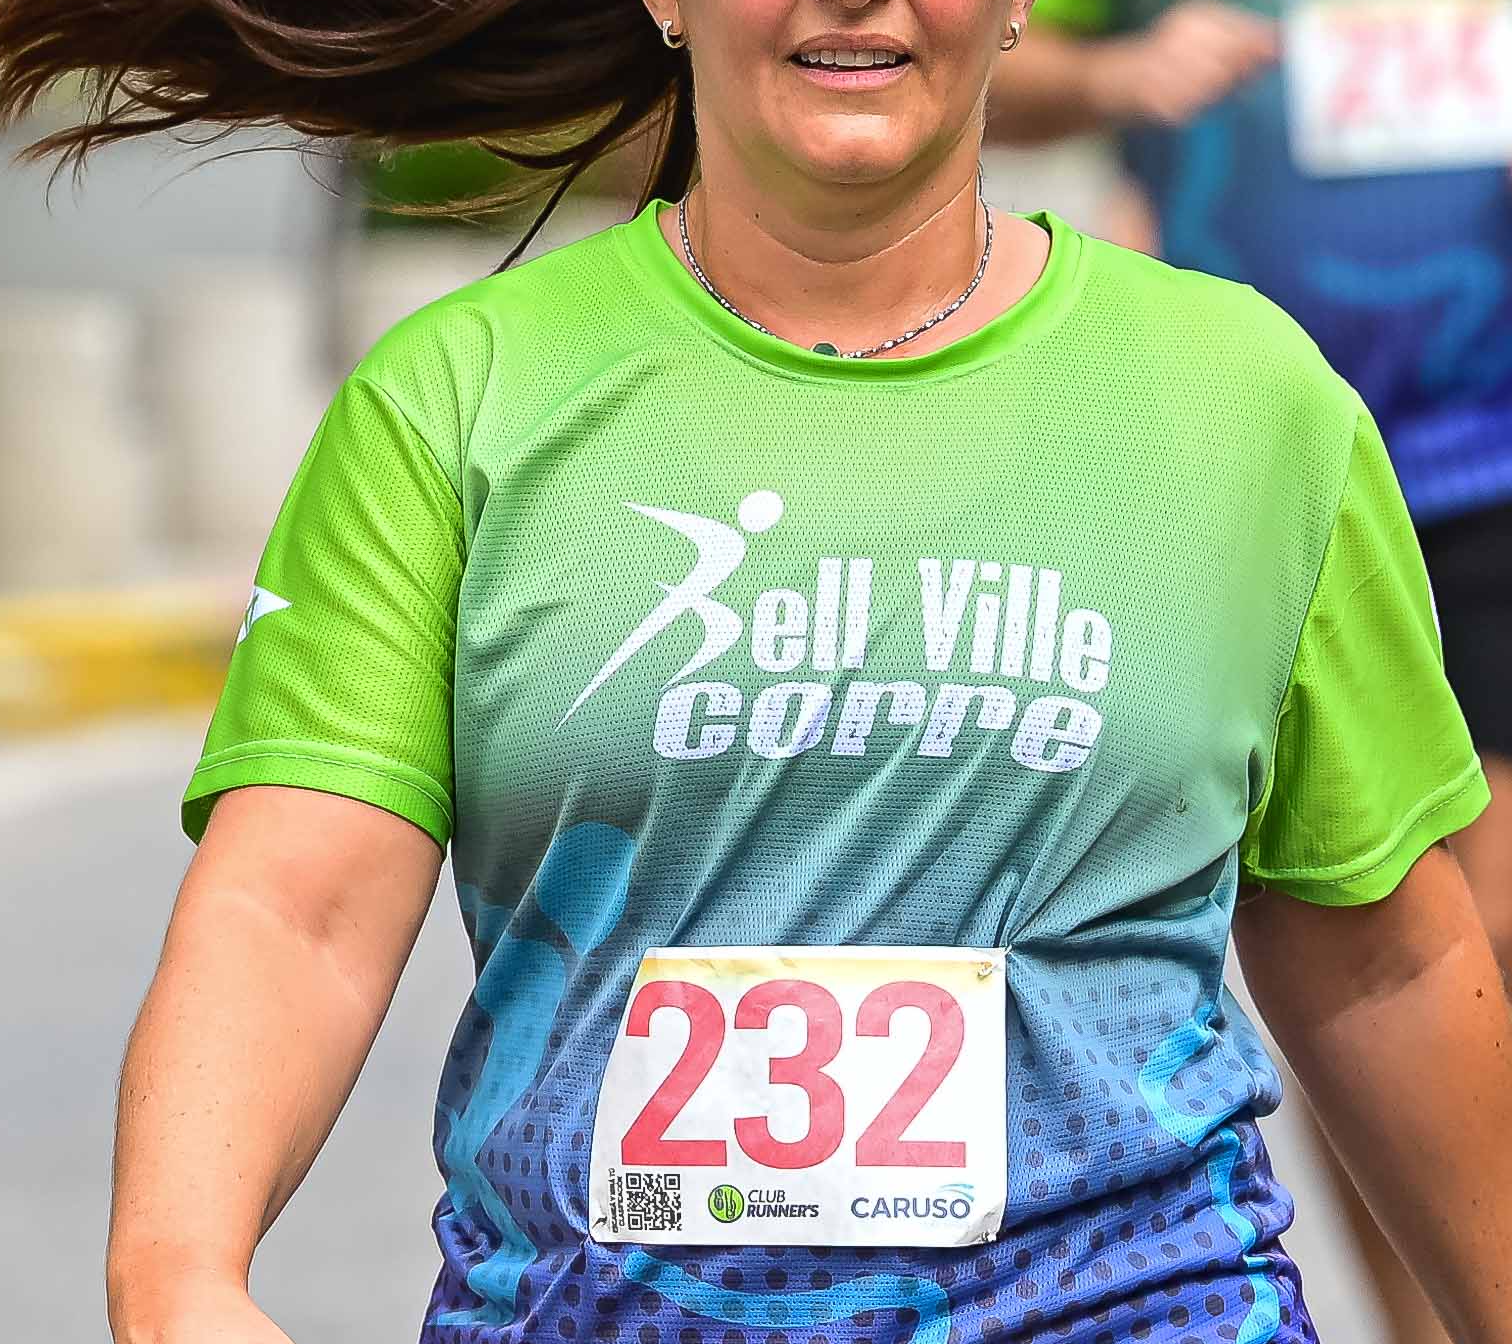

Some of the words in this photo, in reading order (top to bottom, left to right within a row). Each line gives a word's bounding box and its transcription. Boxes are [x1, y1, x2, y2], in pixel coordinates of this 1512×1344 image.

[917, 556, 1113, 693] Ville
[652, 679, 1103, 772] corre
[621, 979, 967, 1169] 232
[747, 1189, 786, 1203] CLUB
[850, 1197, 971, 1218] CARUSO
